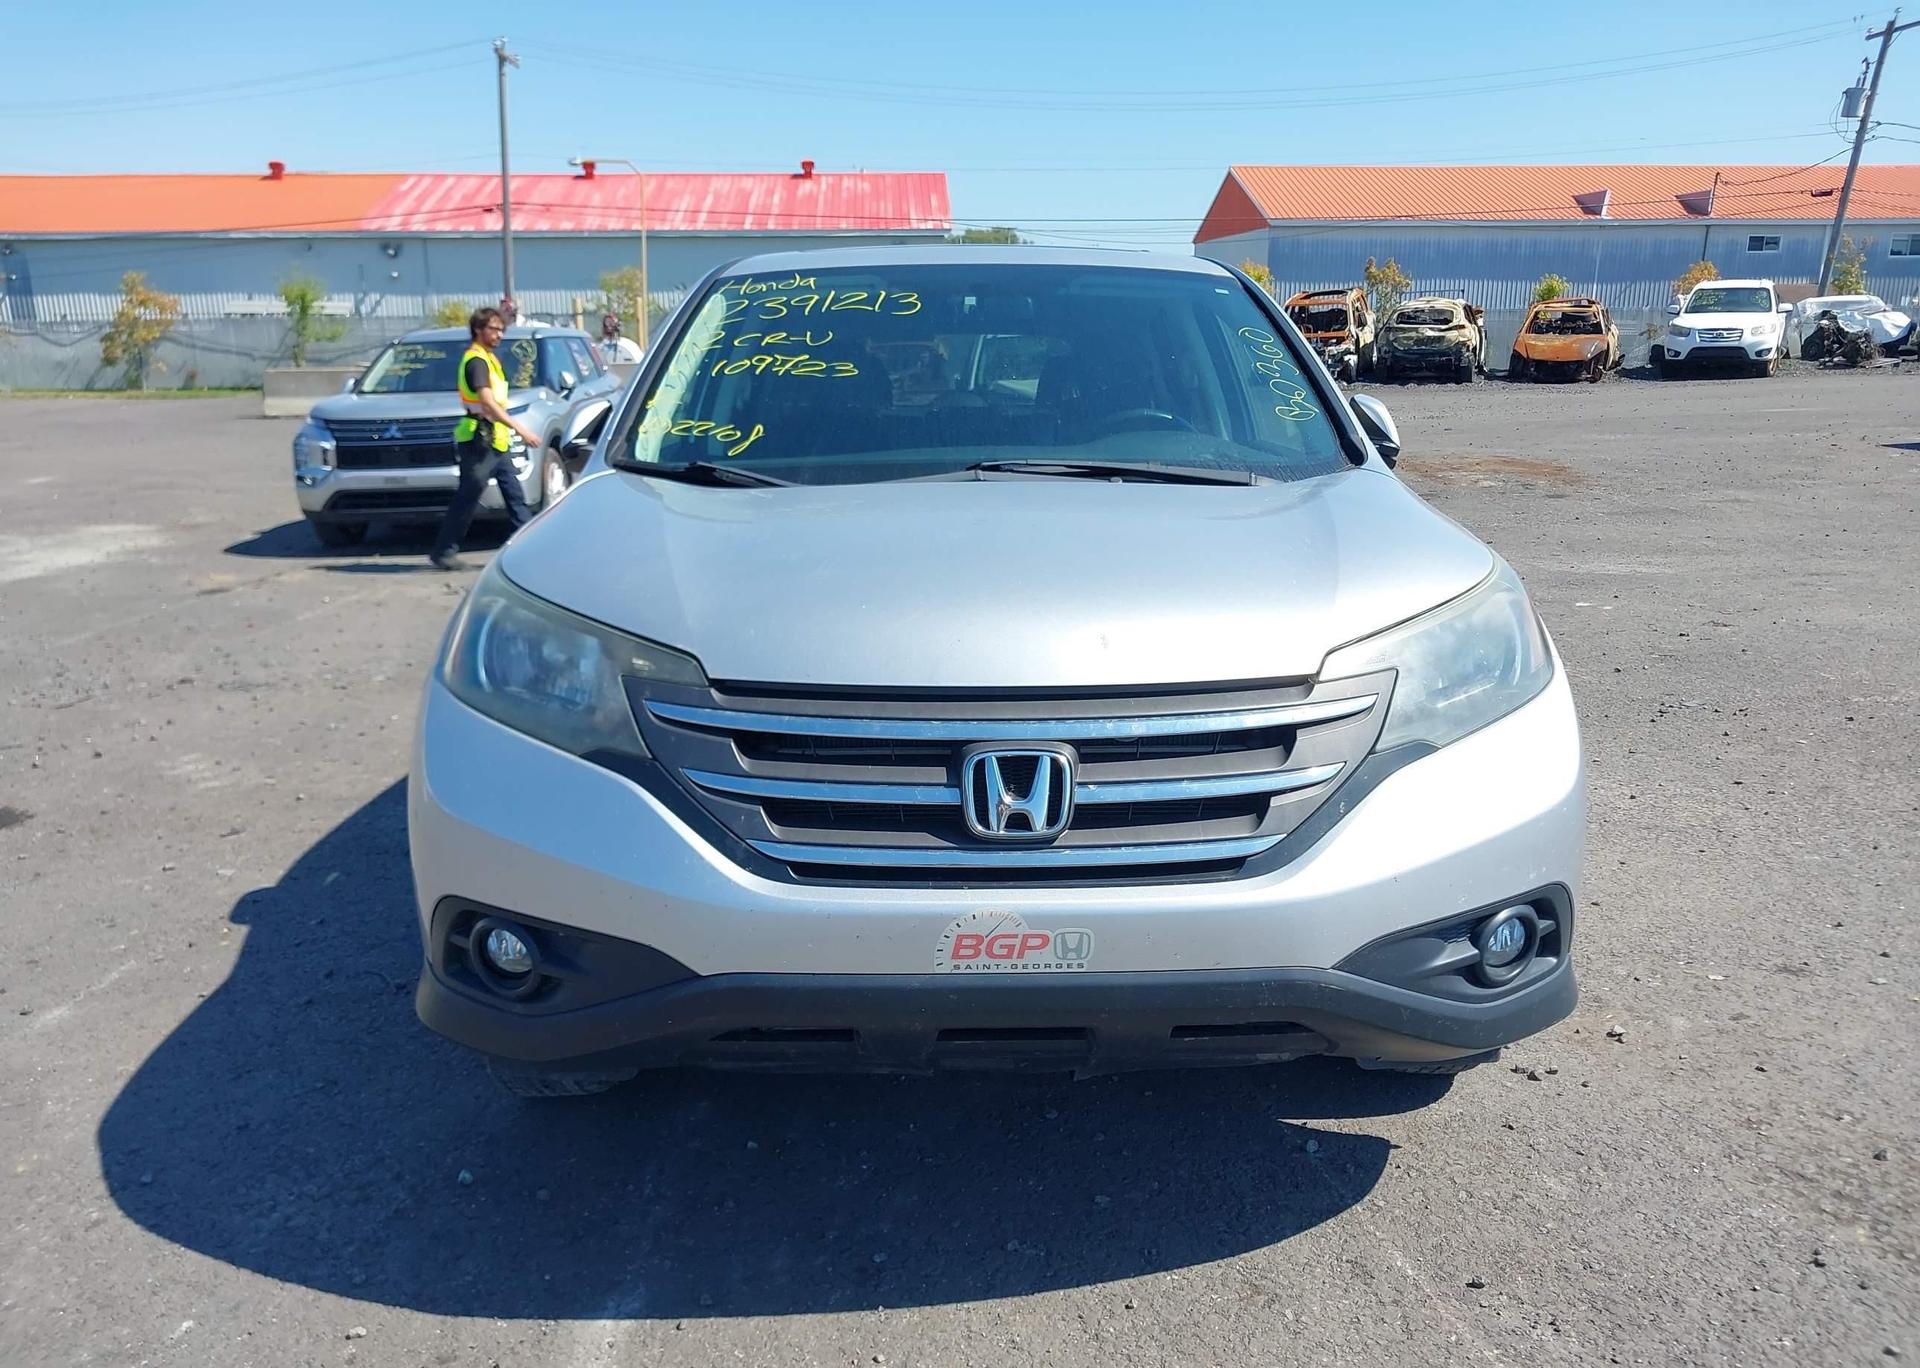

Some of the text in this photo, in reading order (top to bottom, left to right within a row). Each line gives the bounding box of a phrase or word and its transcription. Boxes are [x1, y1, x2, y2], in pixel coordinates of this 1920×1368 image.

[719, 273, 816, 295] Honda
[951, 933, 1050, 960] BGP
[953, 963, 1085, 971] SAINT-GEORGES
